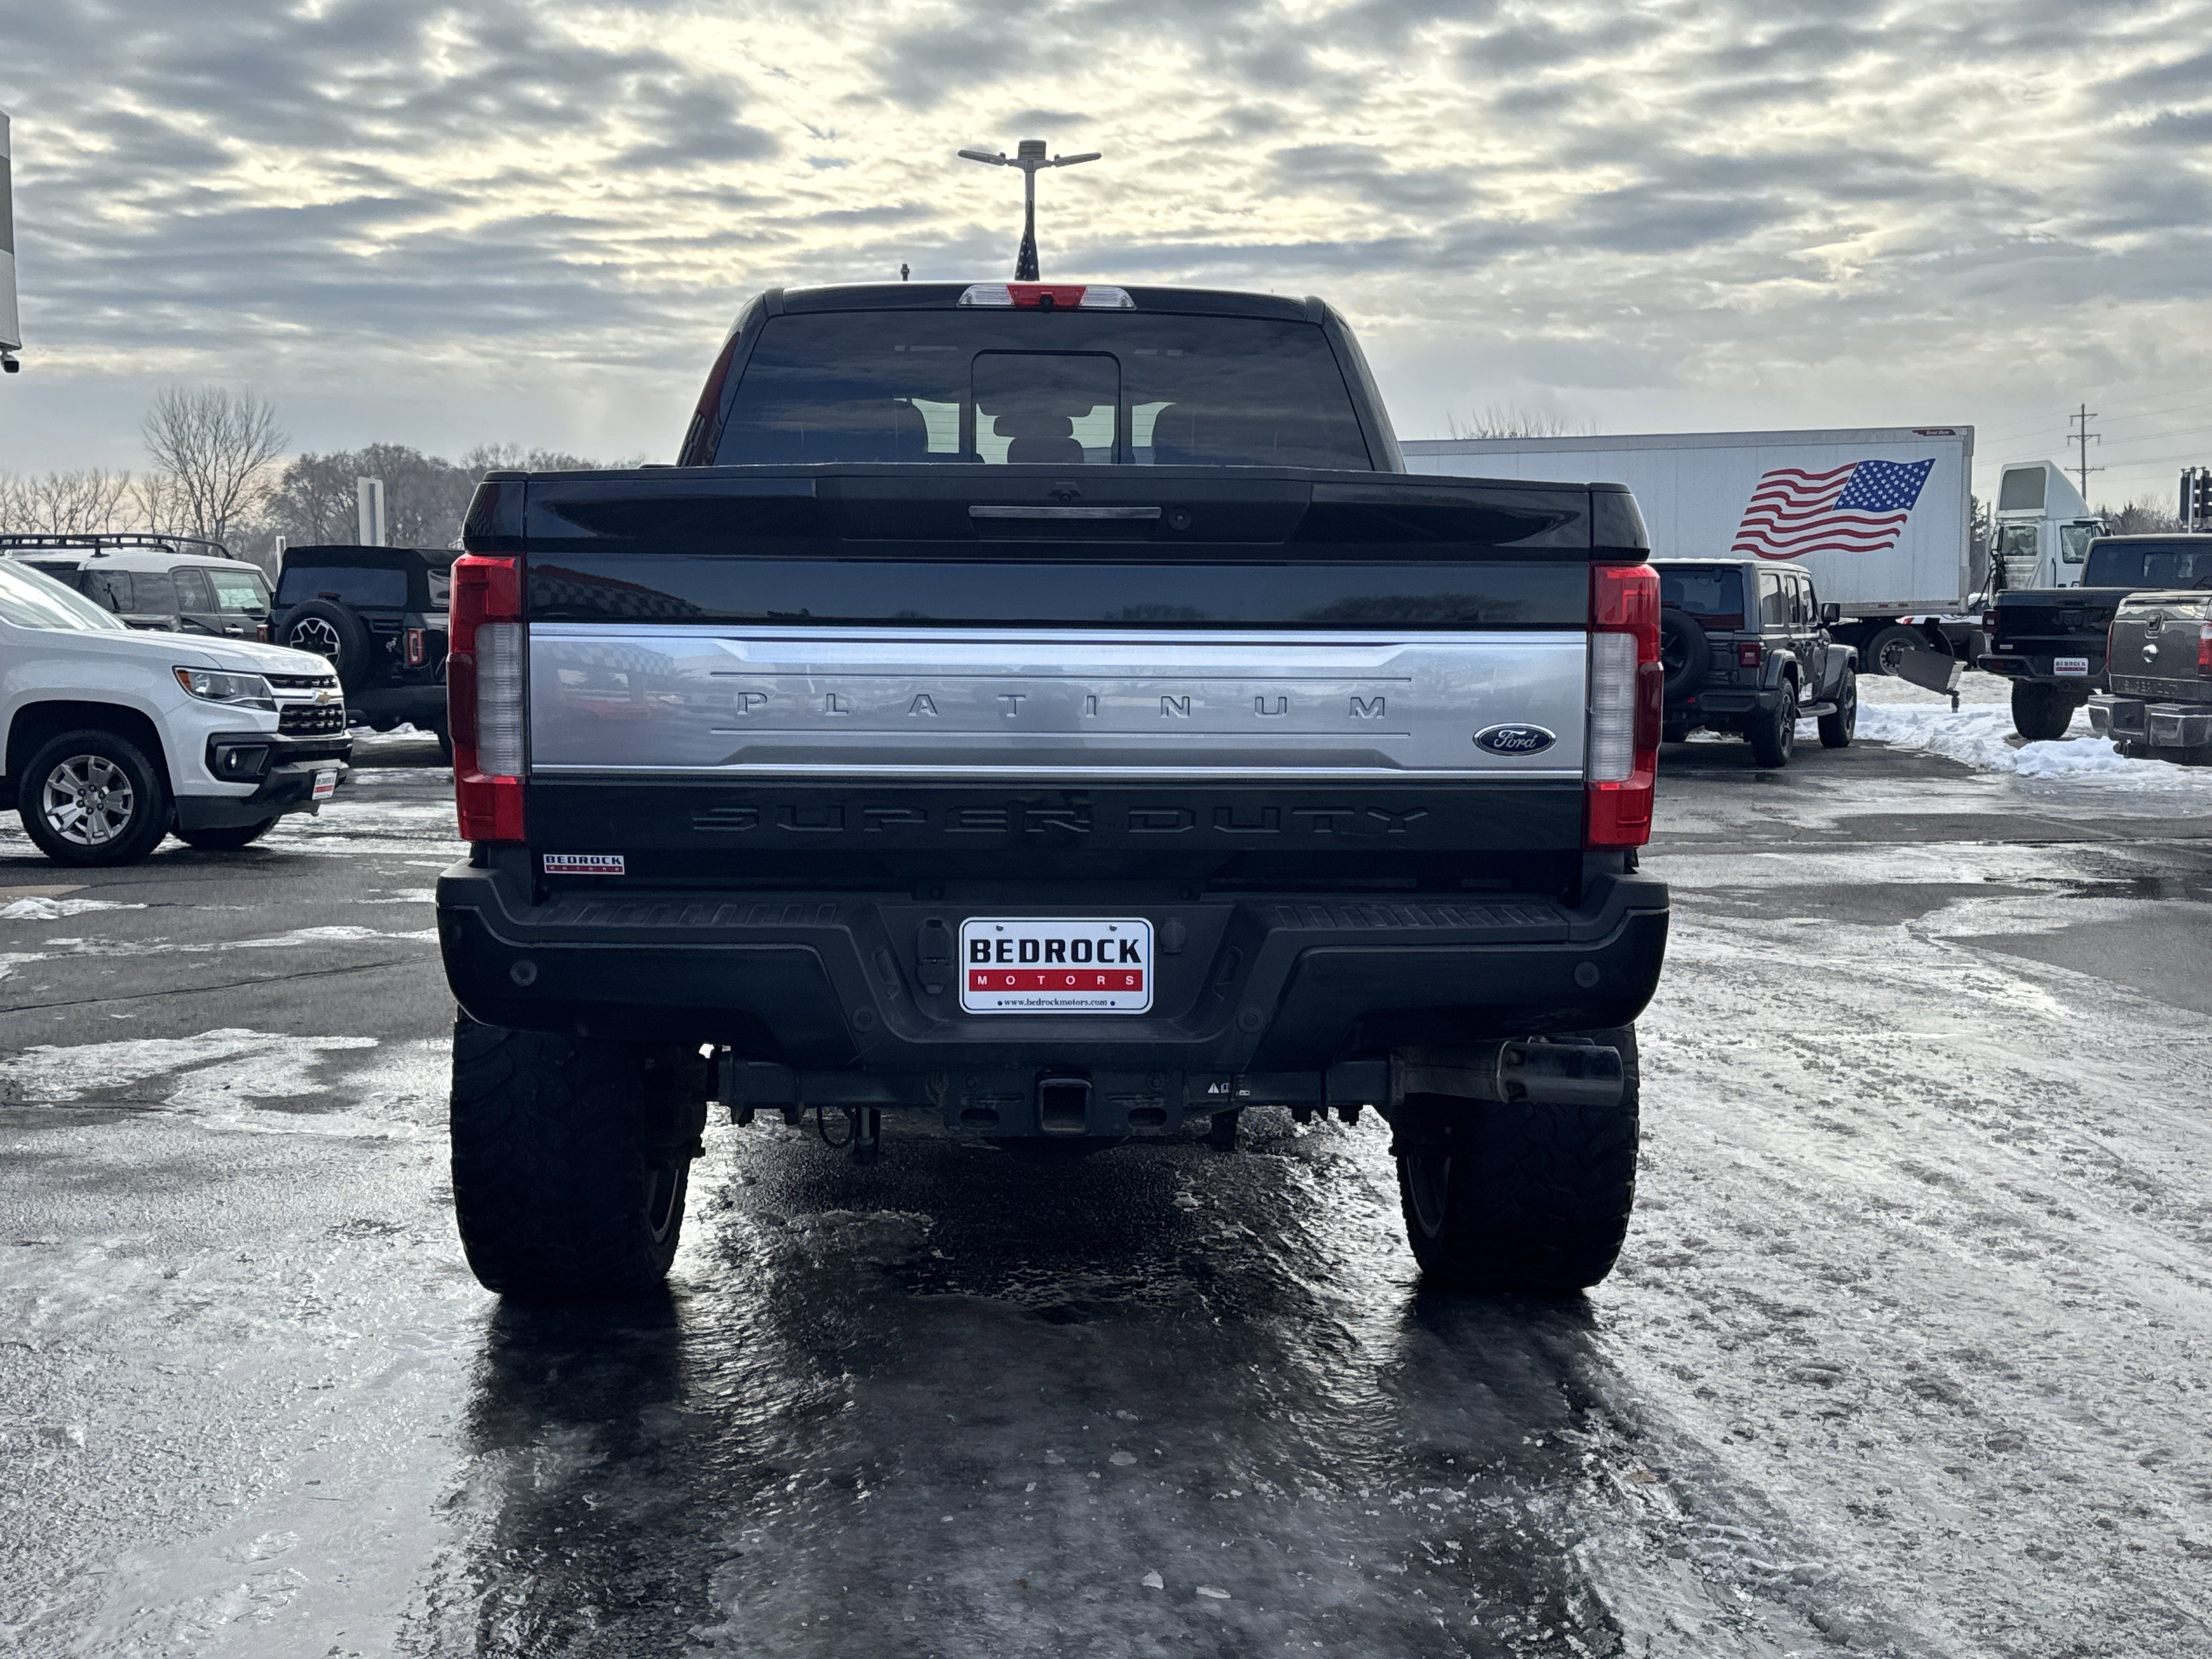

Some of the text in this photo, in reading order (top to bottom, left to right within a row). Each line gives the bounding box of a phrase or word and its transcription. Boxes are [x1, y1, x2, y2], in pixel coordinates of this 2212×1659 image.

[737, 692, 1385, 719] PLATINUM
[1493, 730, 1538, 748] Ford
[692, 805, 1428, 833] SUPER DUTY
[545, 856, 622, 865] BEDROCK
[969, 939, 1142, 963] BEDROCK
[977, 975, 1135, 985] MOTORS
[1003, 998, 1108, 1006] www.bedrockmotors.com
